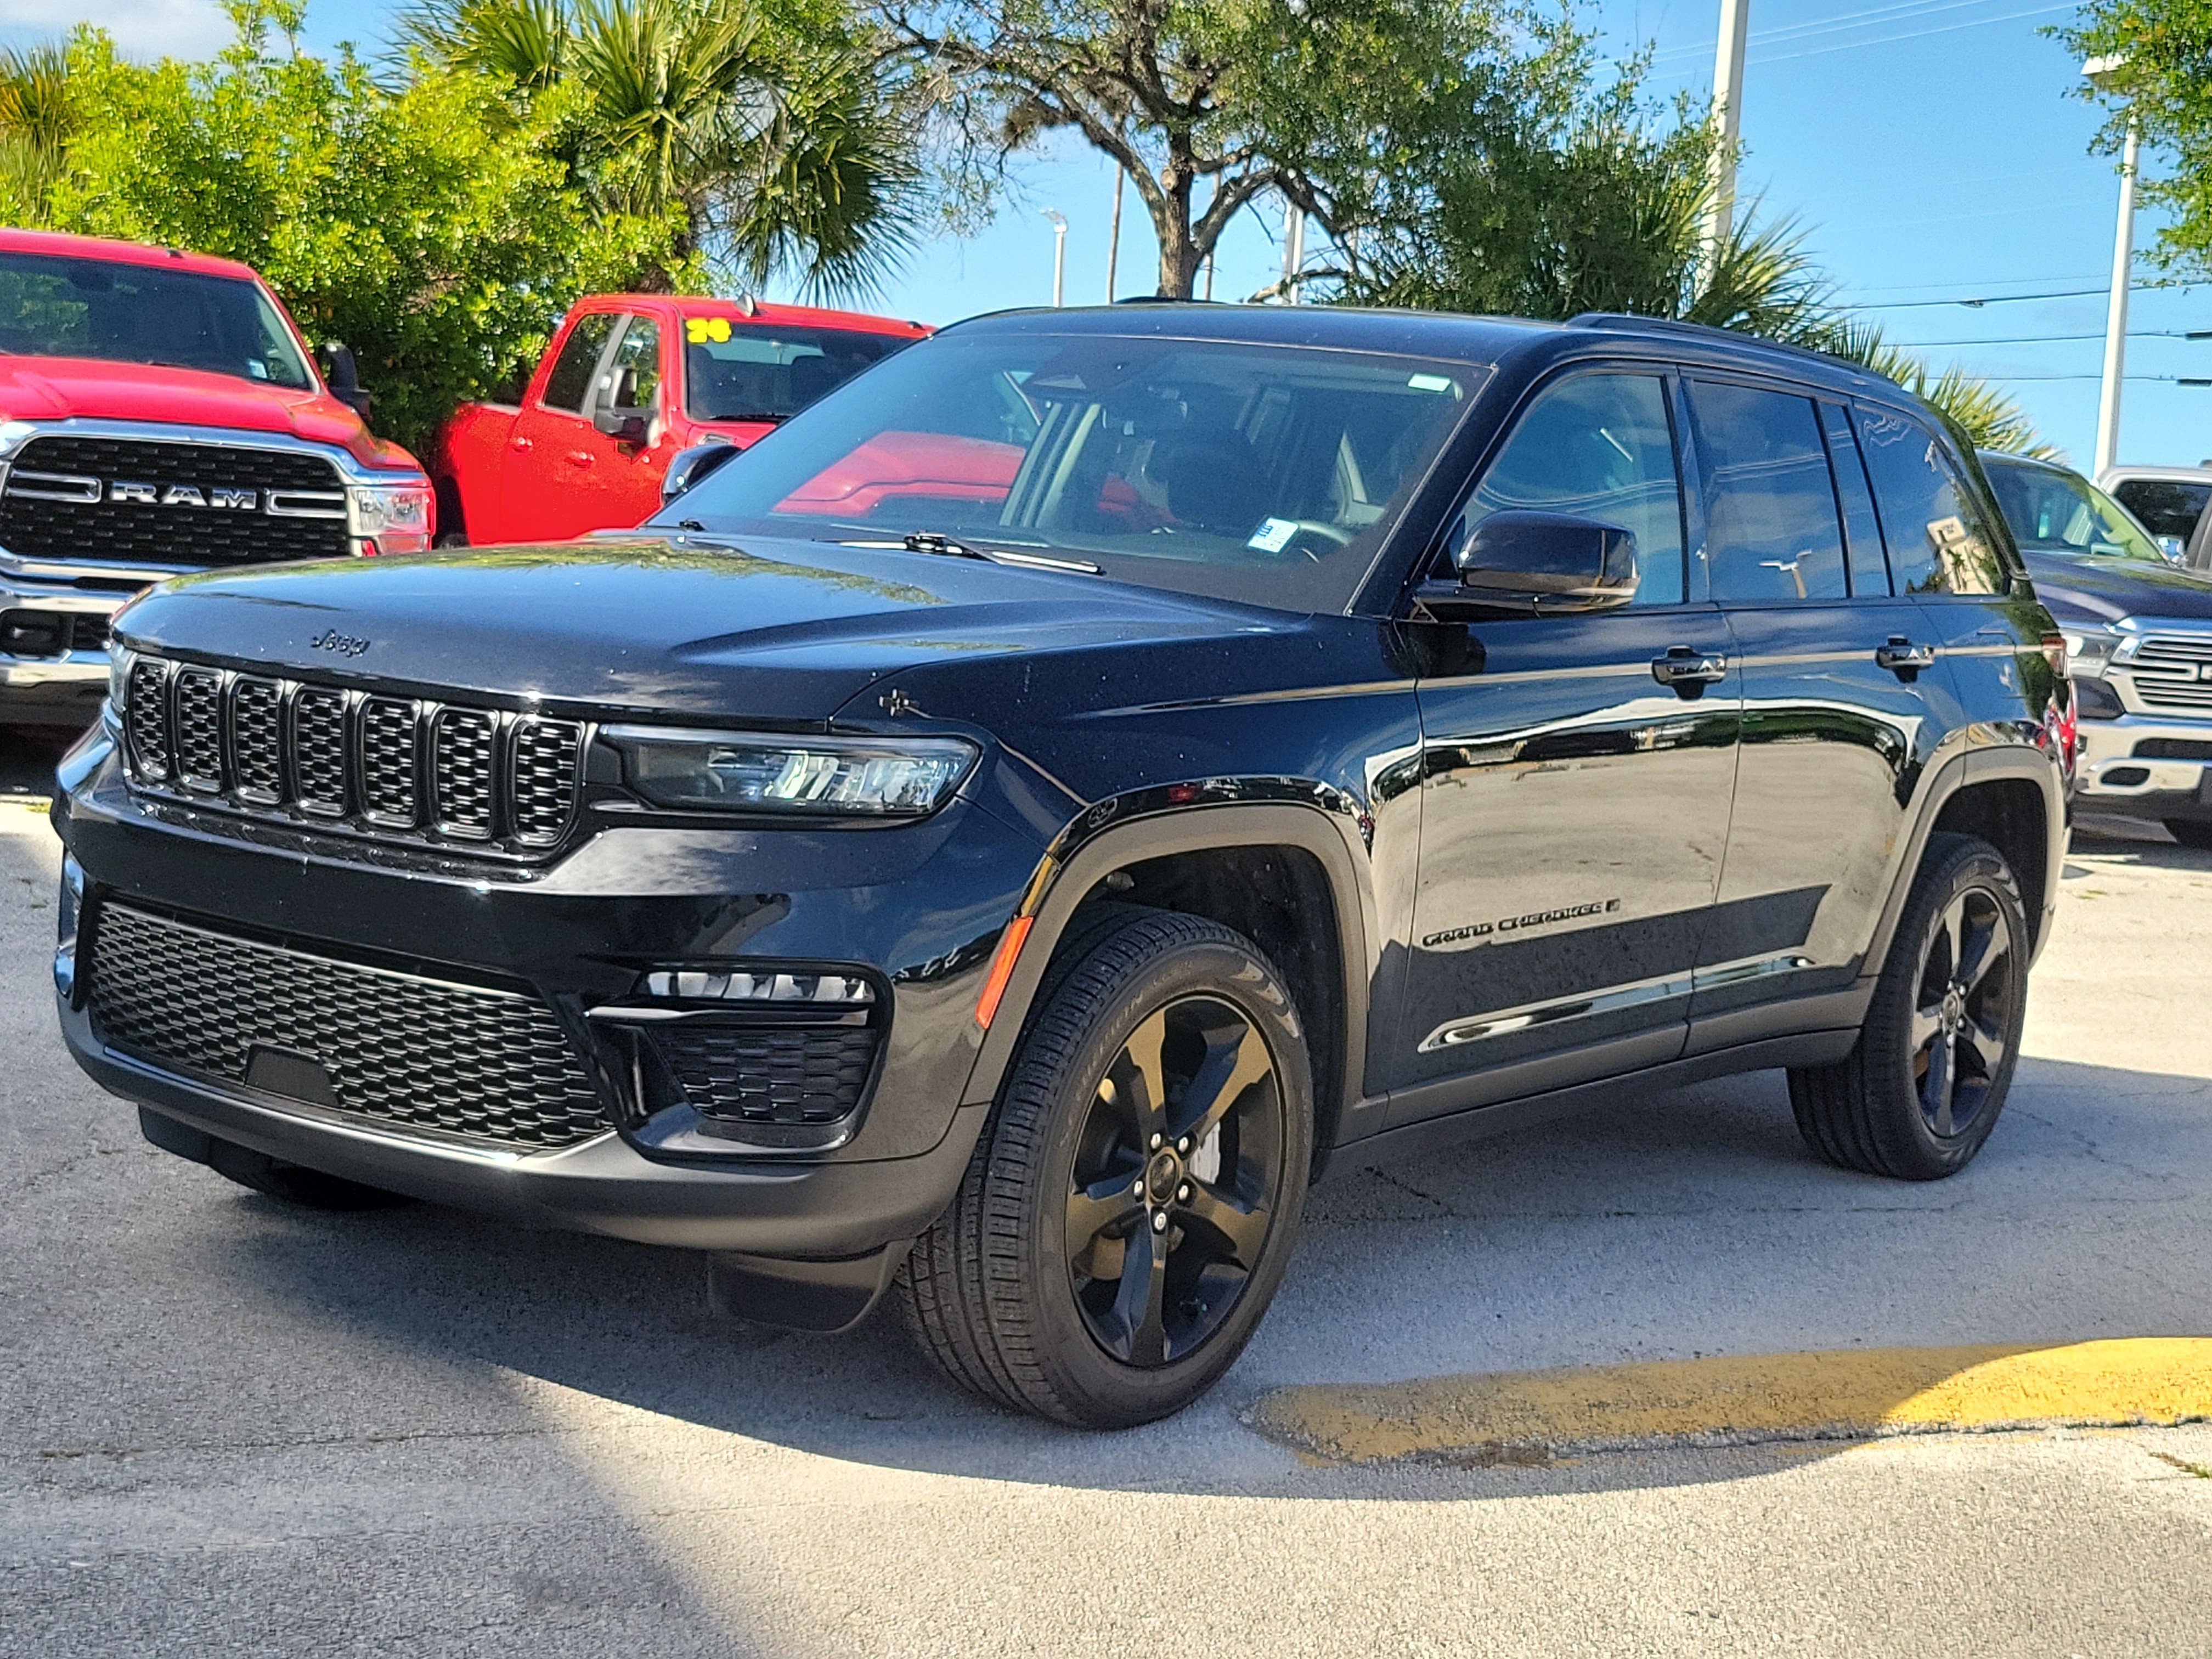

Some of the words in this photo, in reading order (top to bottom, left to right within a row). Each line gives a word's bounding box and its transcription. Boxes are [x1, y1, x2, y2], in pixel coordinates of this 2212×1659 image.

[111, 479, 257, 510] RAM
[310, 629, 370, 658] Jeep
[1423, 923, 1493, 946] GRAND
[1498, 902, 1602, 932] CHEROKEE
